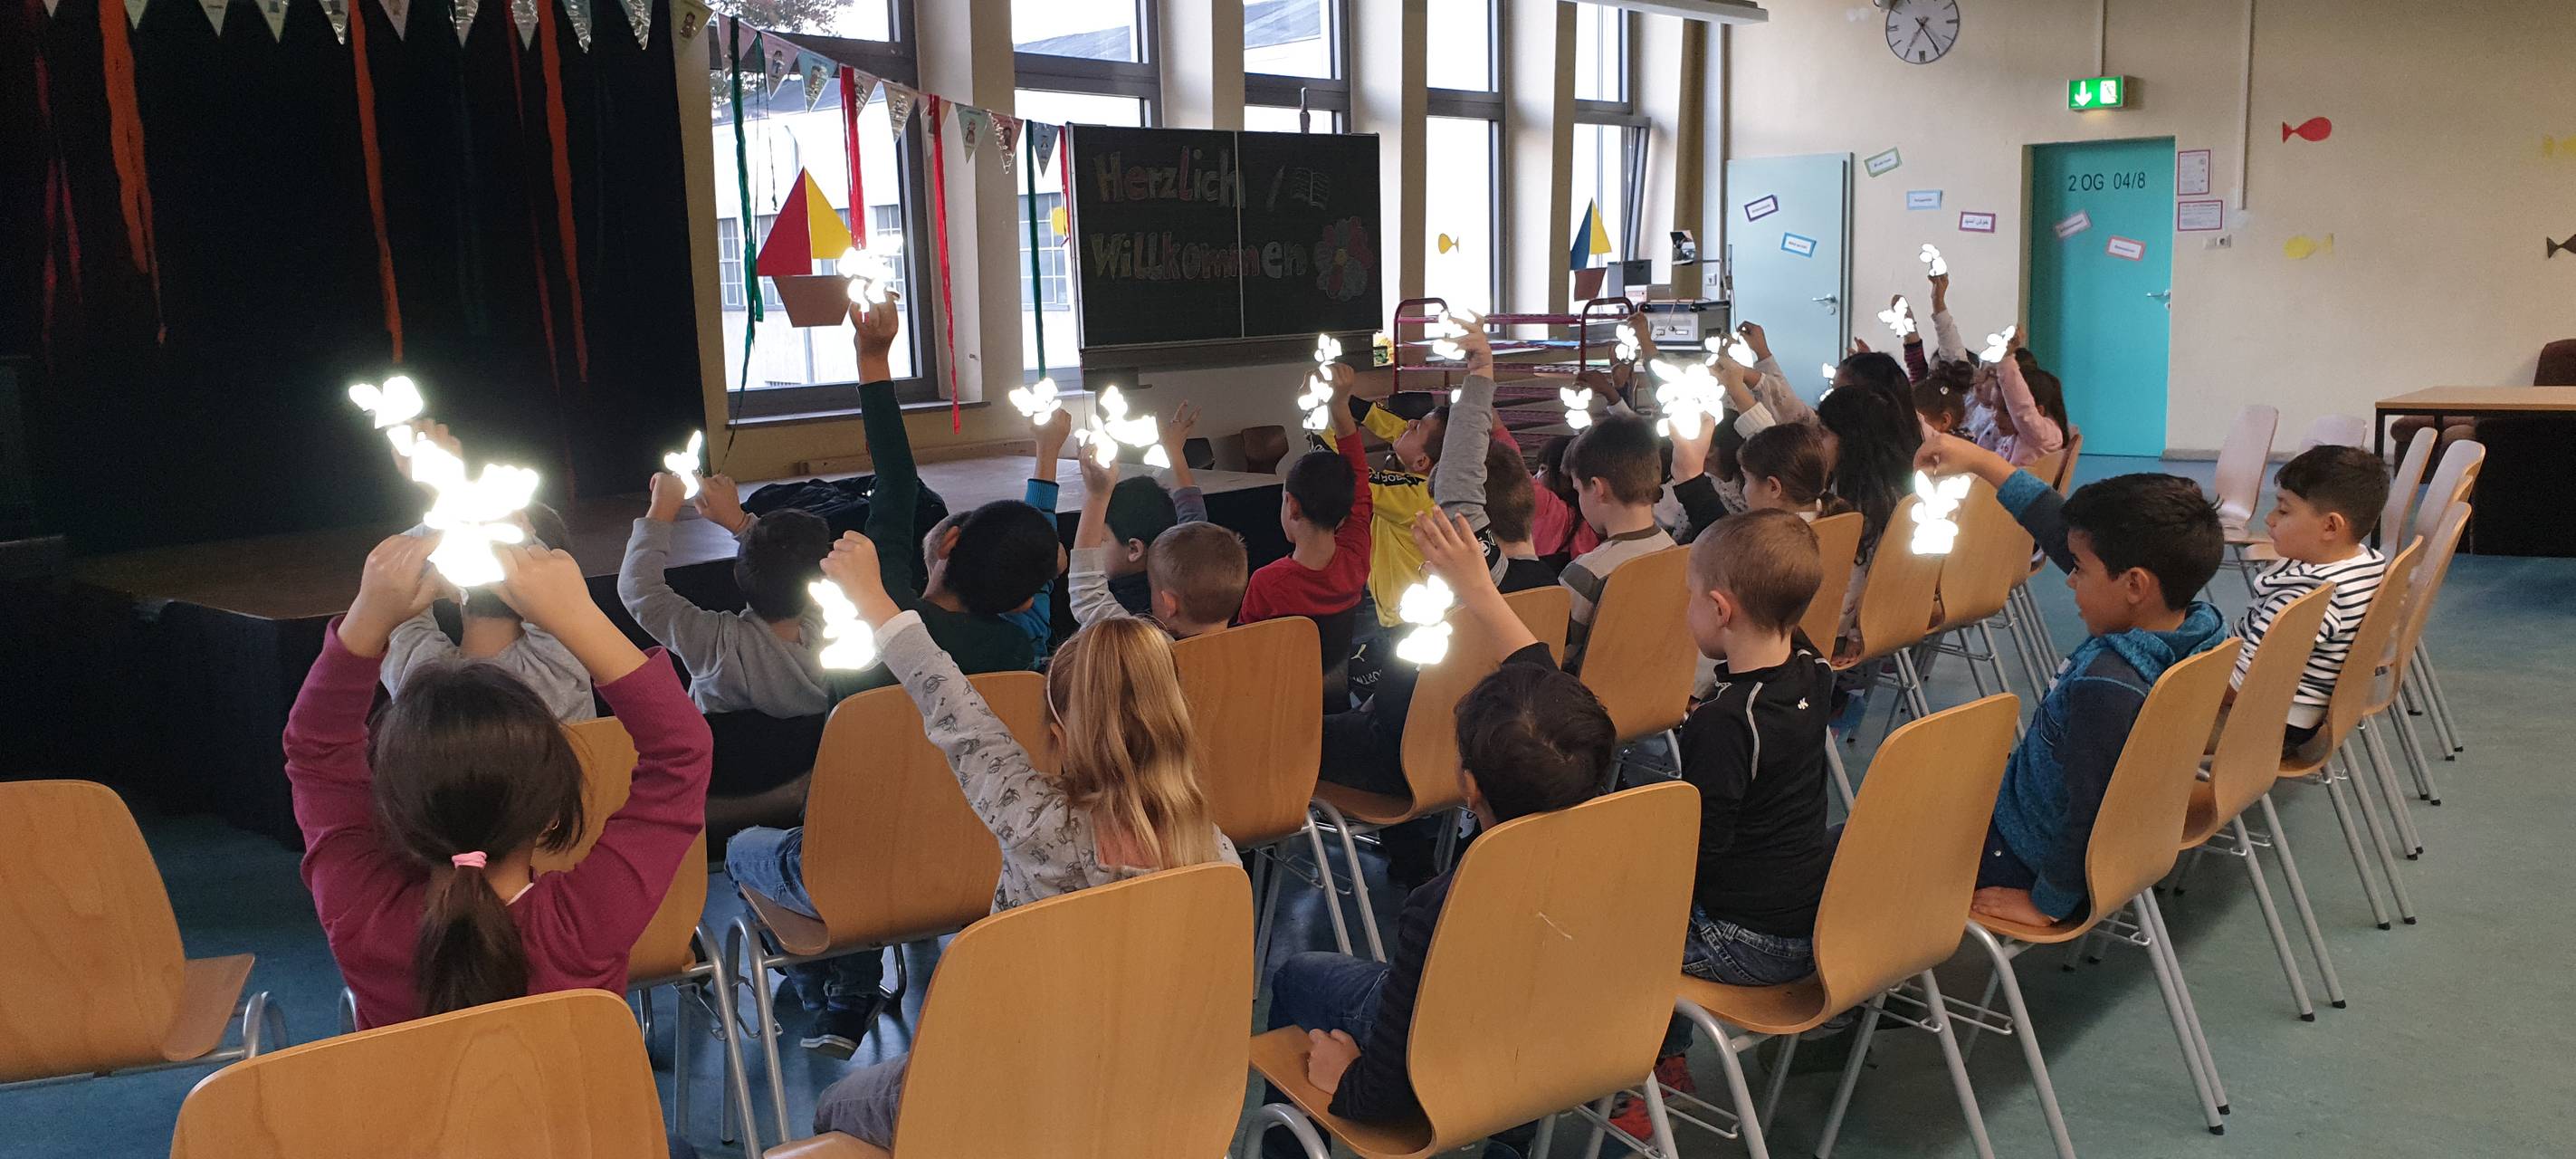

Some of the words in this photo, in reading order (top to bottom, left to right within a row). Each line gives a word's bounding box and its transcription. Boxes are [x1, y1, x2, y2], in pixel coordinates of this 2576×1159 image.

[1093, 145, 1245, 209] Herzlich
[2068, 174, 2077, 191] 2
[2081, 173, 2104, 191] OG
[2113, 171, 2145, 189] 04/8
[1091, 232, 1307, 281] Willkommen
